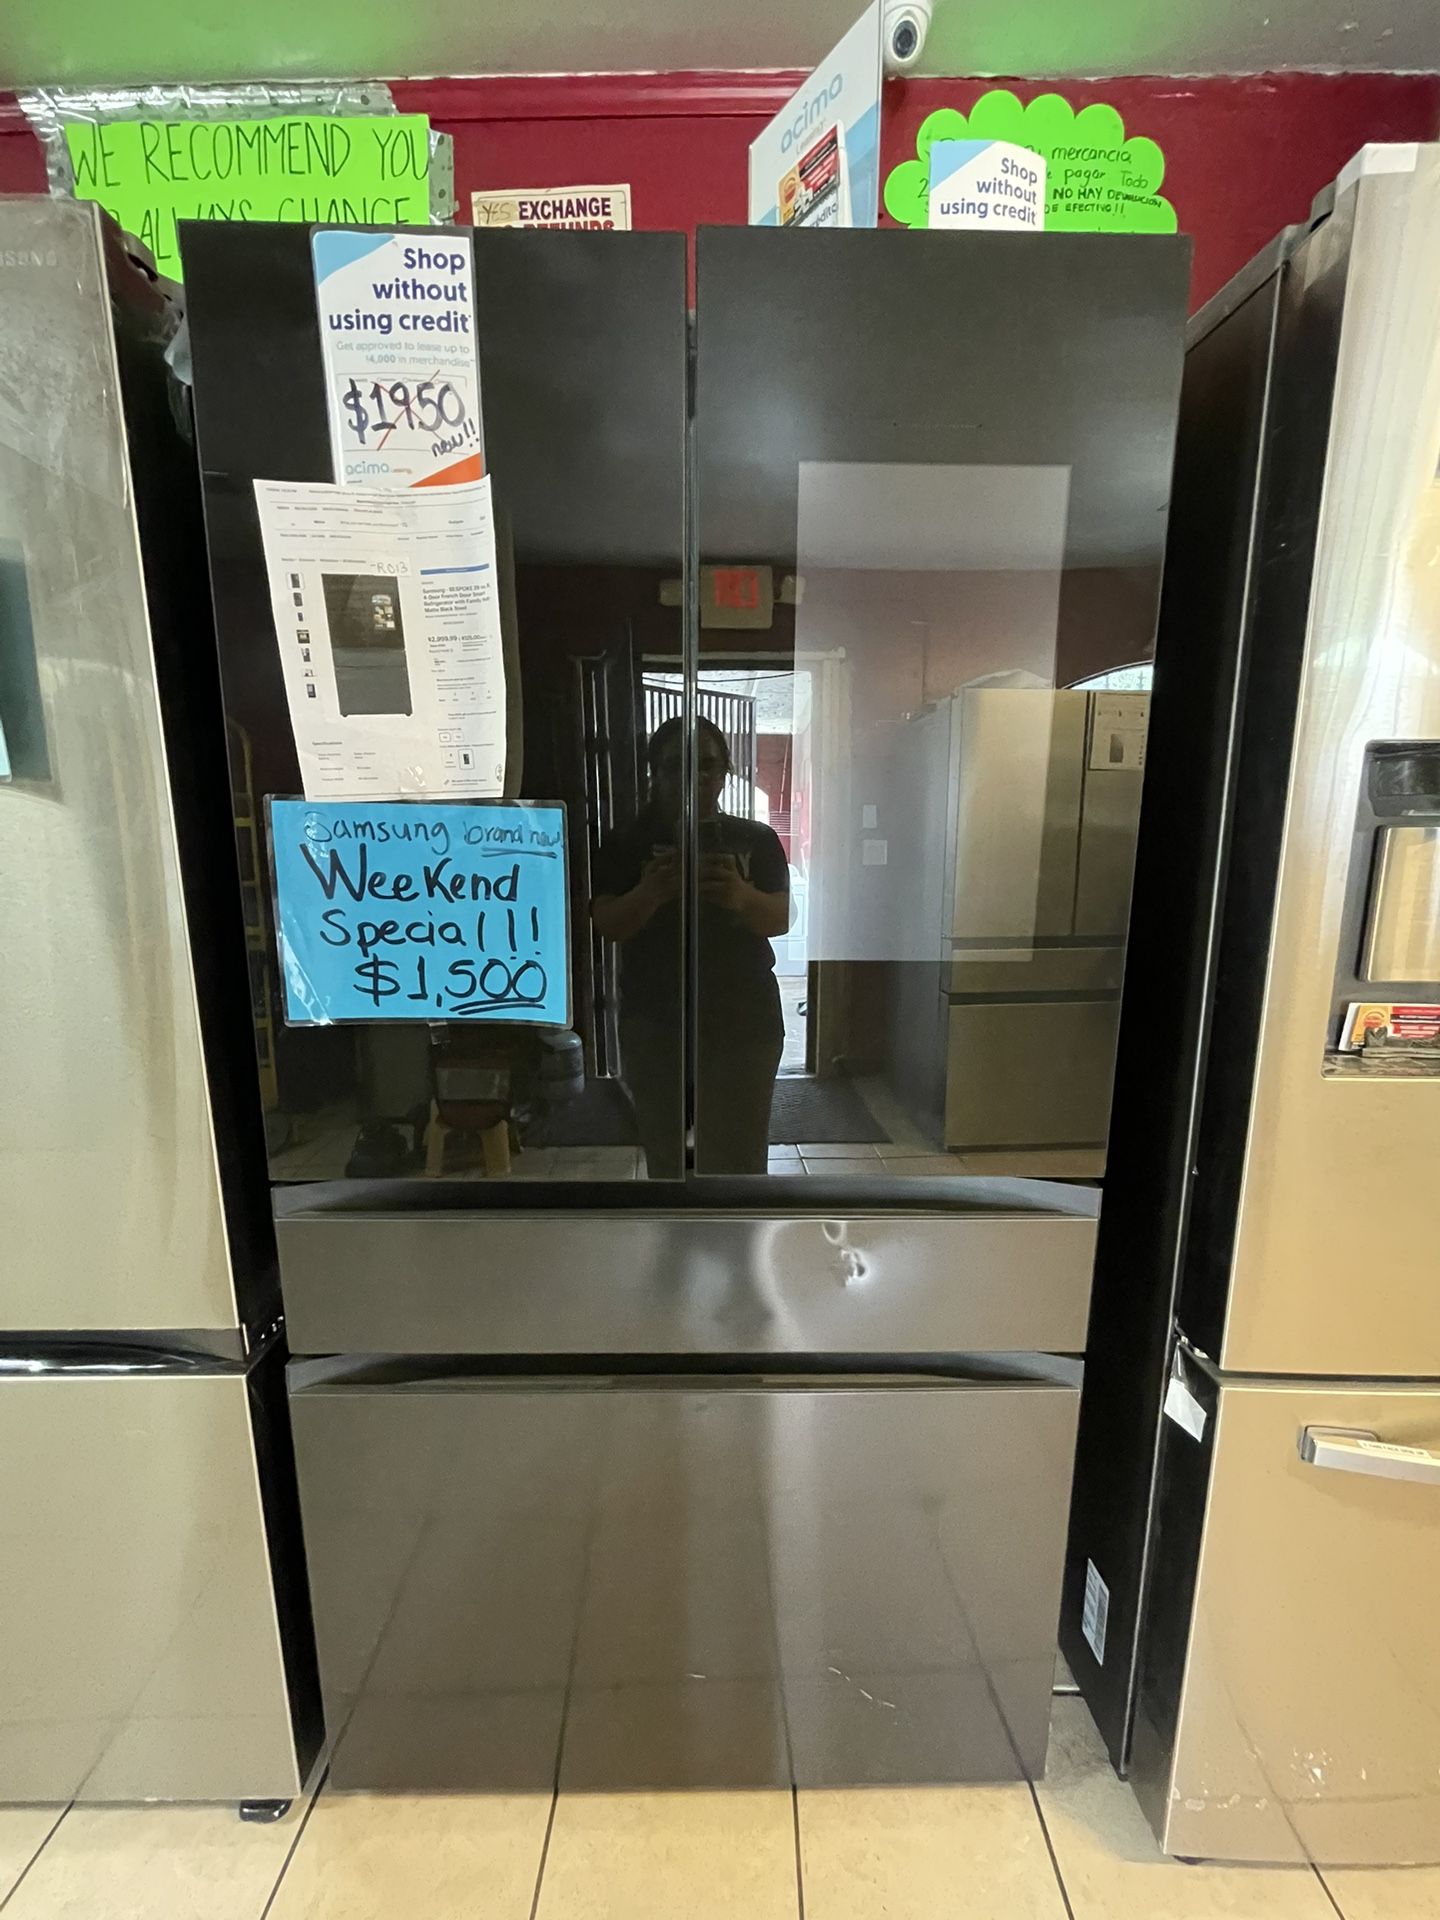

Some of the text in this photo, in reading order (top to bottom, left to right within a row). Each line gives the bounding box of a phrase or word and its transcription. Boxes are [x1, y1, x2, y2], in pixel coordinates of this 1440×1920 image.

[781, 73, 843, 154] acimo
[73, 120, 429, 187] WE RECOMMEND YOU
[1001, 157, 1038, 186] Shop
[1064, 168, 1106, 188] pagar
[976, 177, 1037, 205] without
[1053, 187, 1073, 200] NO
[1078, 187, 1103, 200] HAY
[519, 197, 611, 221] EXCHANGE
[940, 197, 1037, 226] using credit
[403, 247, 465, 275] Shop
[372, 277, 468, 302] without
[329, 308, 470, 335] using credit
[336, 340, 470, 354] Get approved to lease up to
[409, 355, 470, 368] merchandise
[343, 378, 465, 445] $1950
[345, 460, 390, 475] acimo
[304, 812, 449, 855] Samsung
[353, 953, 547, 1007] $1,500
